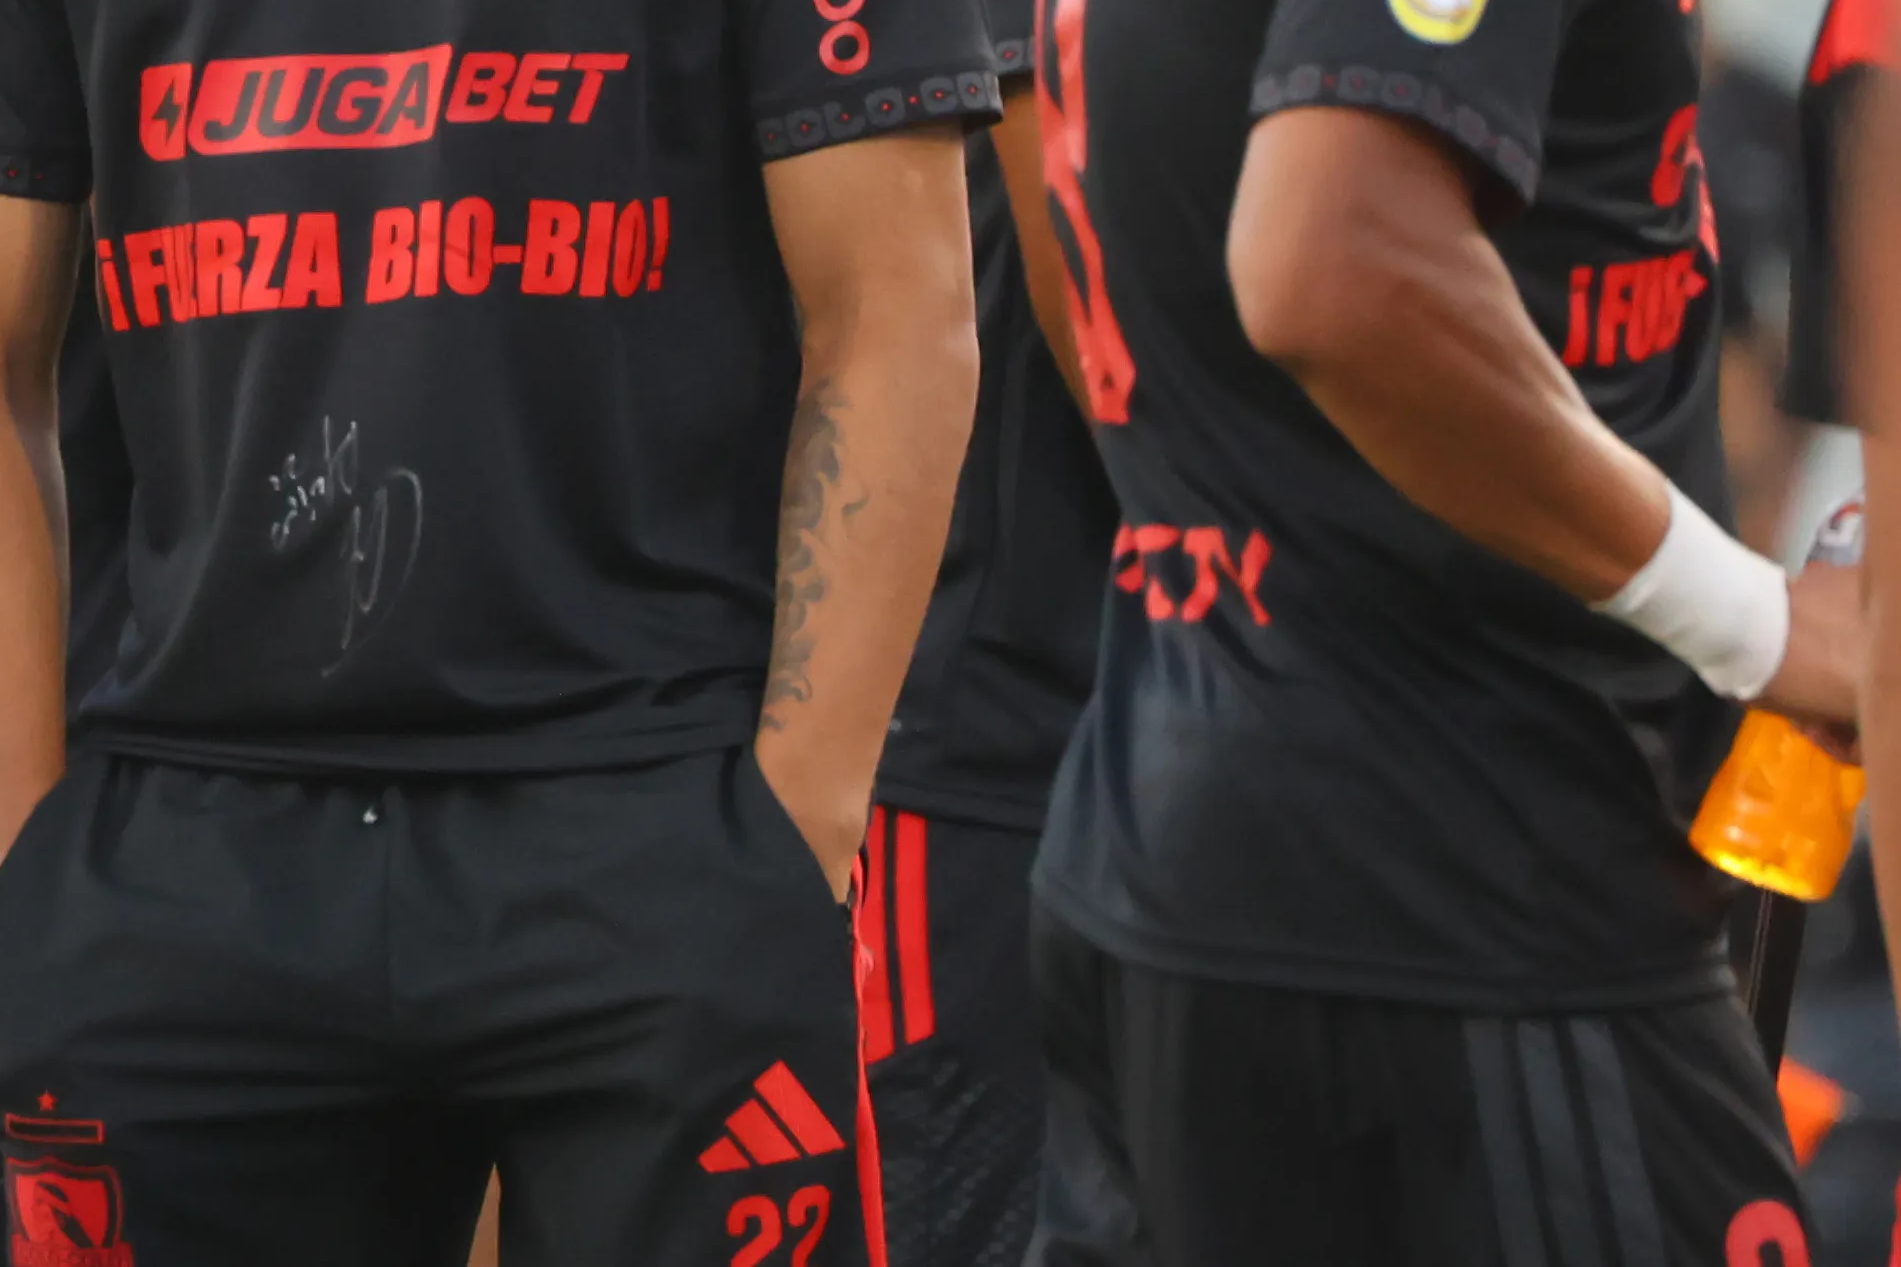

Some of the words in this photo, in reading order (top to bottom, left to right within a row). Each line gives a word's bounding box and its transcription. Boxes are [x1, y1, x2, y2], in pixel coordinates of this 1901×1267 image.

[204, 52, 629, 144] JUGABET
[98, 212, 342, 331] ¡FUERZA
[366, 196, 670, 303] BIO-BIO!
